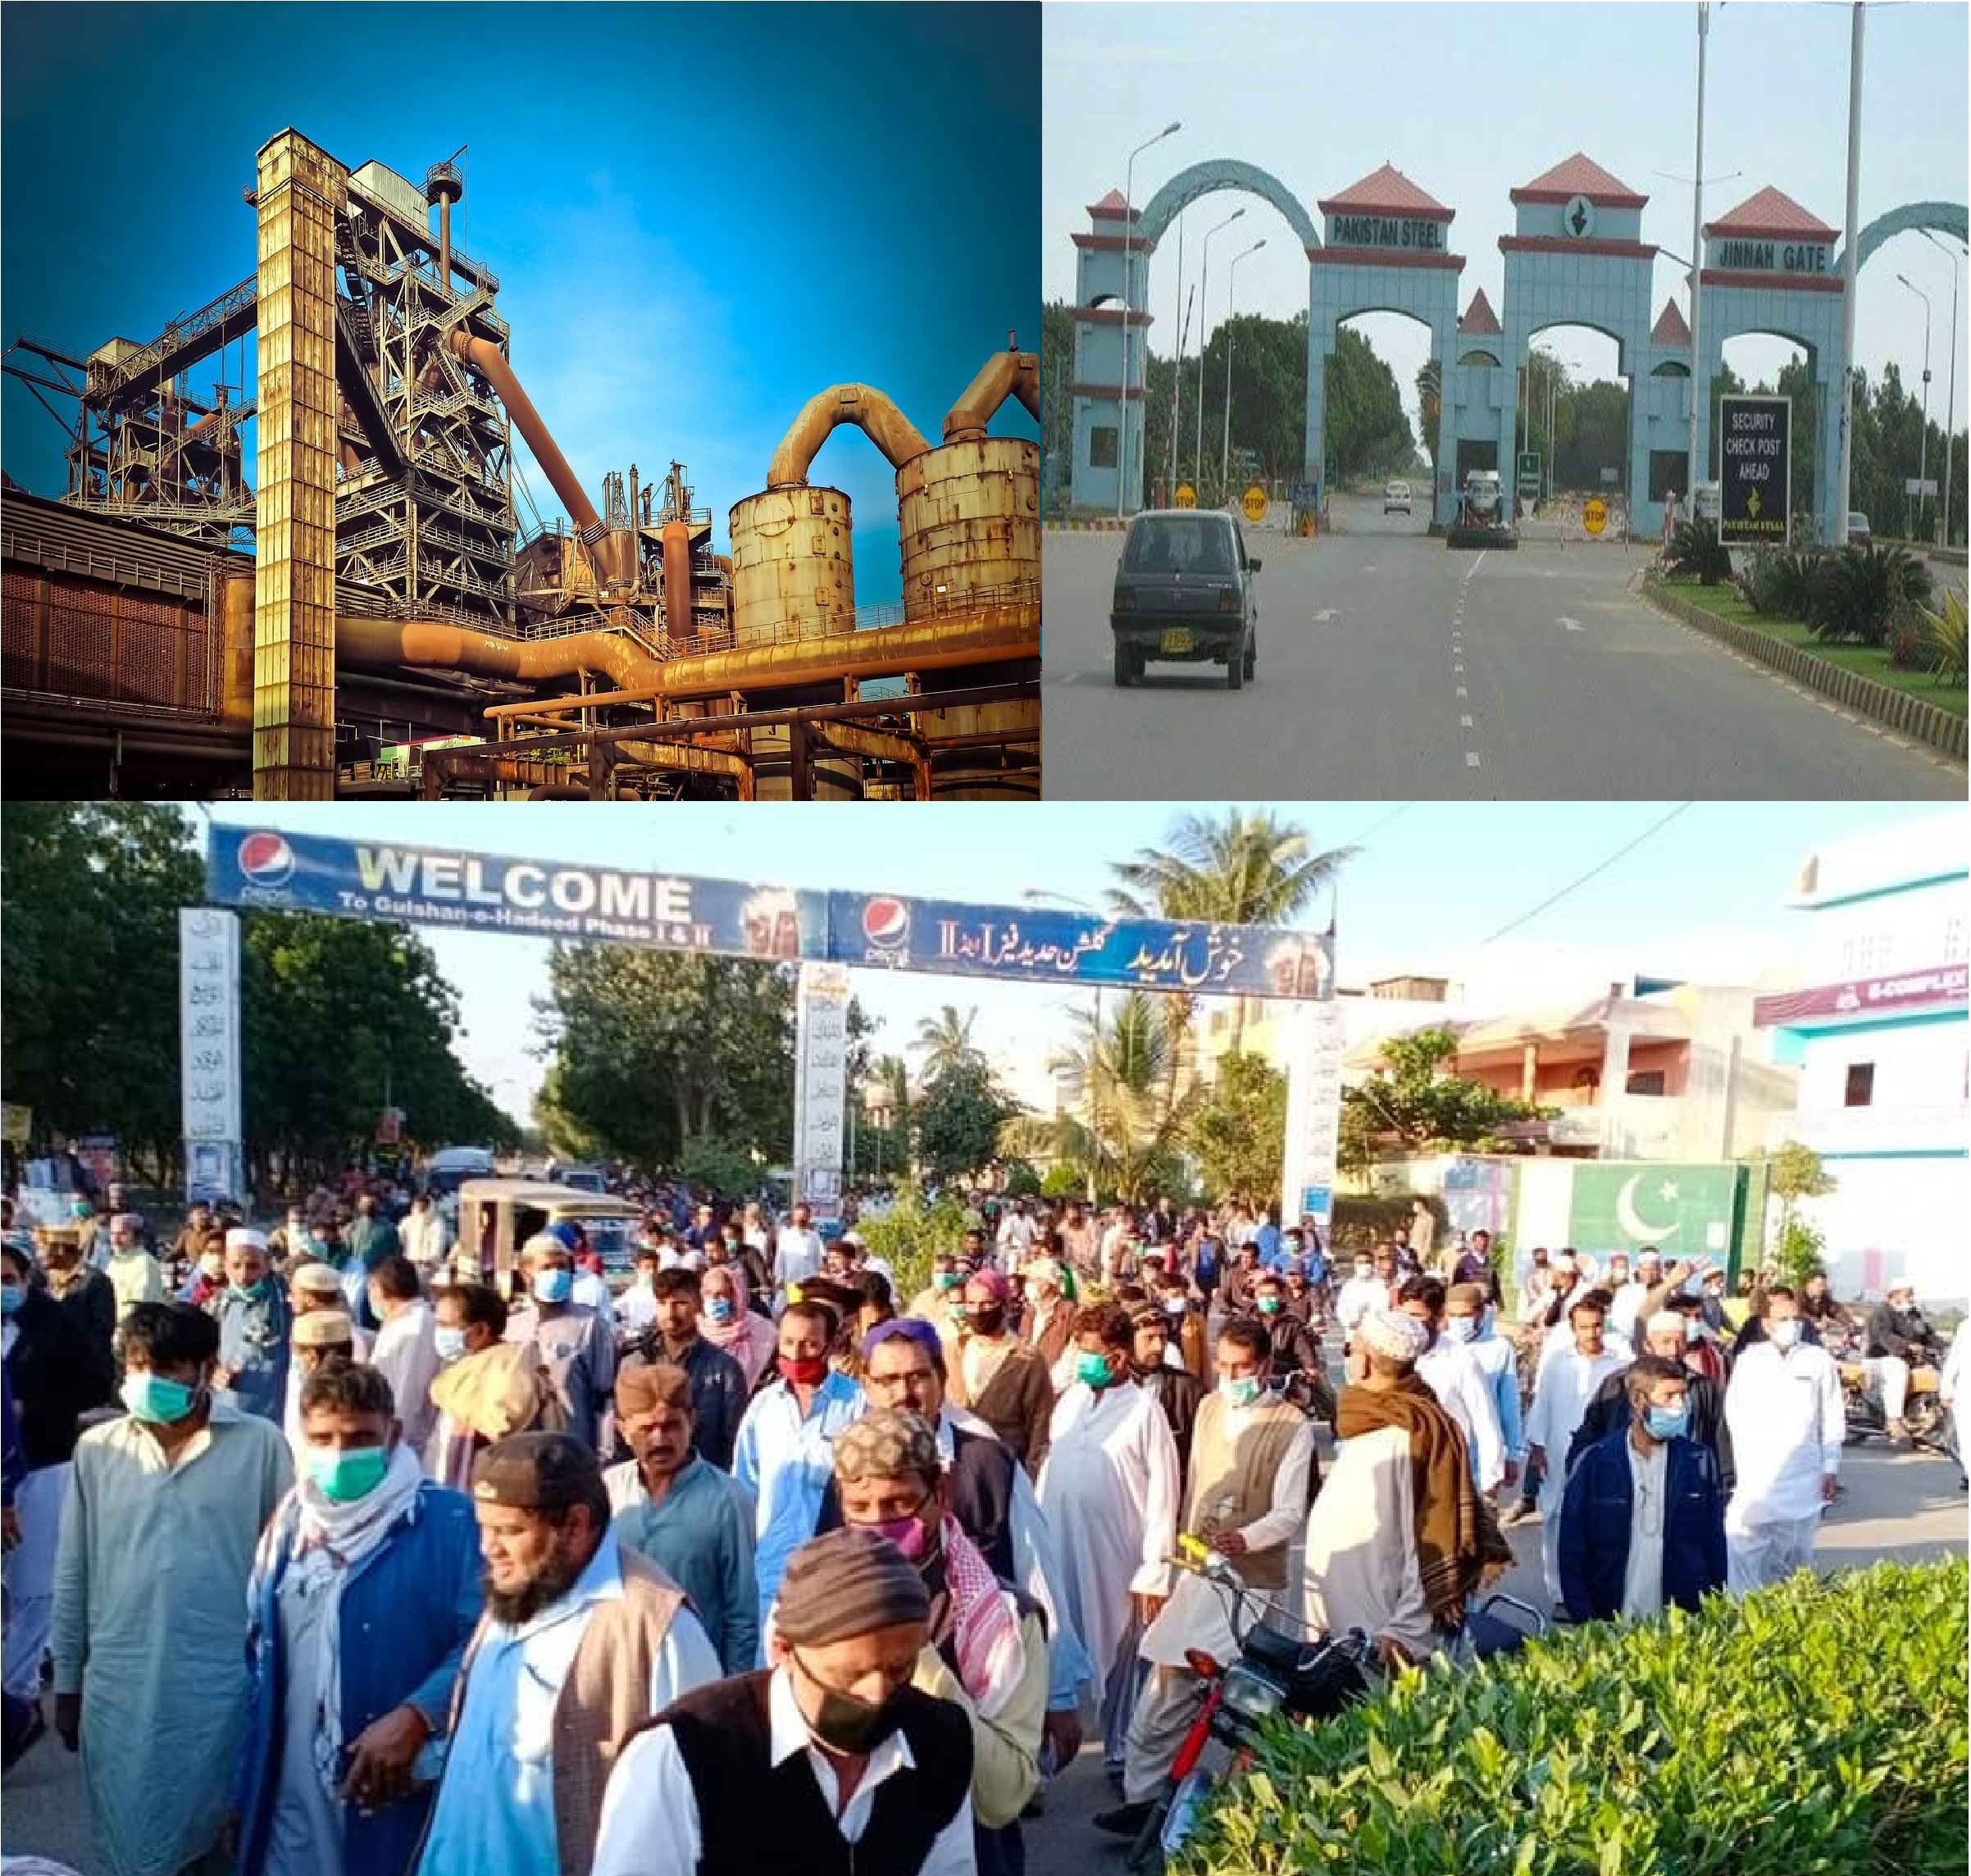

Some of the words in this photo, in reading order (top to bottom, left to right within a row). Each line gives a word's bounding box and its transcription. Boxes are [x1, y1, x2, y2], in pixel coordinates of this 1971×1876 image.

[1334, 216, 1398, 245] PAKISTAN
[1401, 220, 1442, 248] STEEL
[1720, 240, 1774, 269] JINNAH
[1784, 245, 1826, 272] GATE
[1732, 412, 1776, 430] SECURITY
[1726, 438, 1756, 456] CHECK
[1759, 438, 1782, 456] POST
[1739, 463, 1770, 480] AHEAD
[1177, 495, 1195, 508] STOP
[1245, 497, 1266, 510] STOP
[1585, 511, 1605, 522] STOP
[356, 846, 693, 922] WELCOME
[337, 890, 368, 911] To
[585, 918, 653, 940] Phase
[670, 926, 689, 944] &
[1181, 925, 1244, 986] خوش
